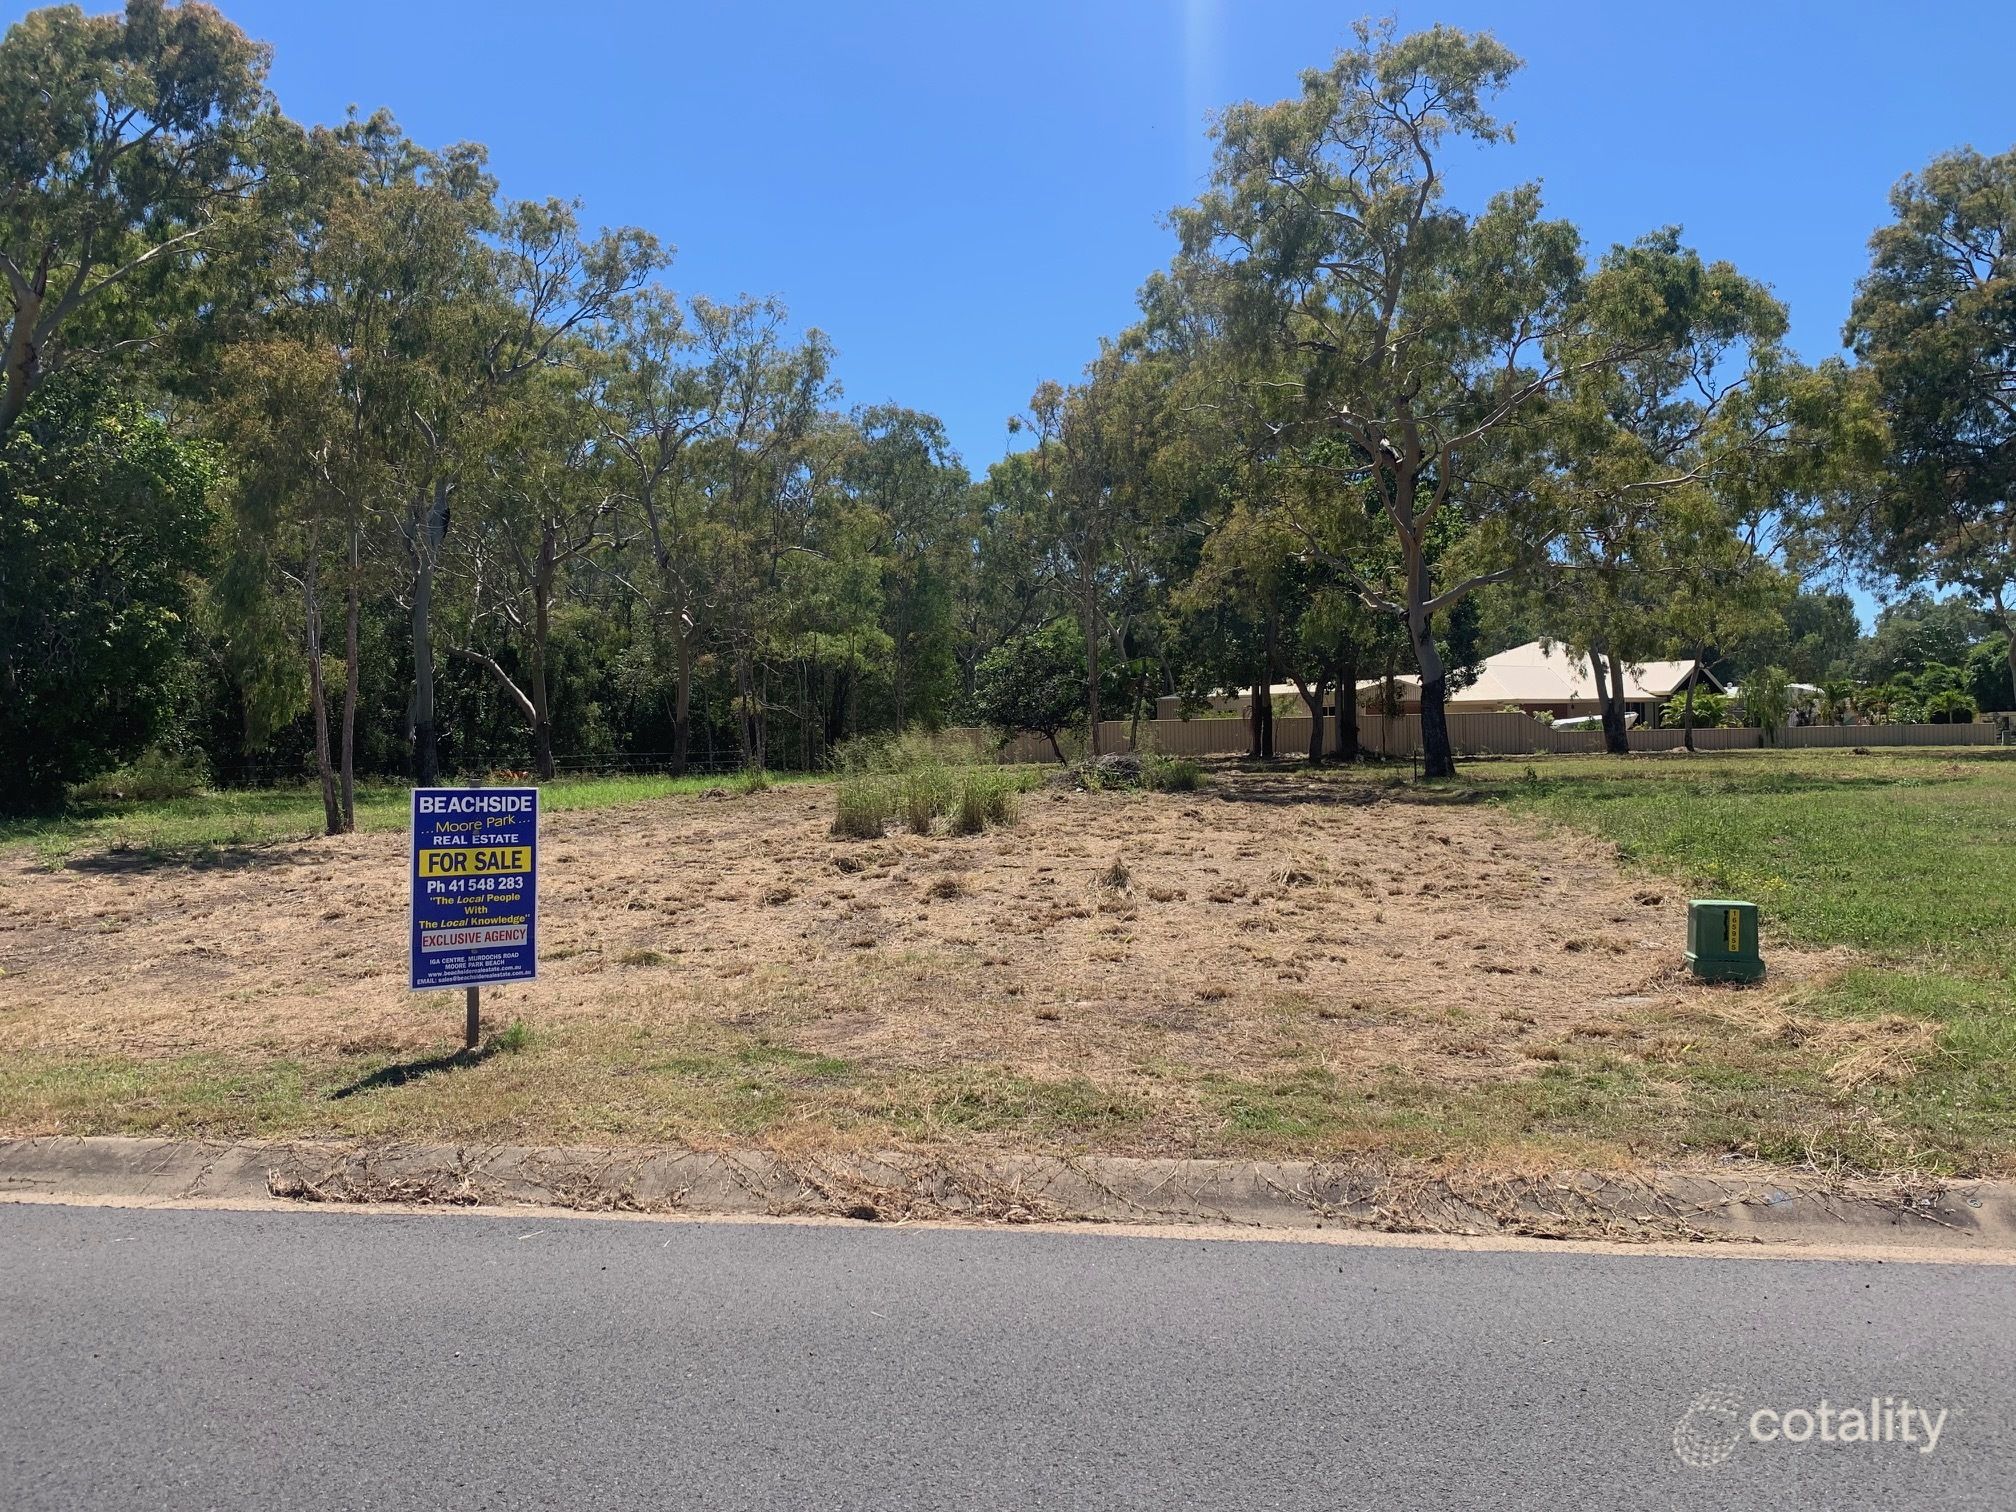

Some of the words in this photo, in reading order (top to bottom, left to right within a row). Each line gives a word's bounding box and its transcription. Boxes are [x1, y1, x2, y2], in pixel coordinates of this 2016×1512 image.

[419, 796, 532, 813] BEACHSIDE
[487, 814, 516, 828] Park
[433, 835, 468, 845] REAL
[472, 834, 519, 844] ESTATE
[428, 852, 467, 873] FOR
[474, 850, 523, 871] SALE
[427, 880, 445, 893] Ph
[498, 876, 524, 890] 283
[457, 894, 484, 904] Local
[487, 893, 521, 903] People
[464, 905, 488, 914] With
[419, 920, 438, 929] The
[441, 918, 469, 928] Local
[422, 931, 482, 947] EXCLUSIVE
[484, 928, 527, 943] AGENCY
[468, 953, 502, 961] MURDOCHS
